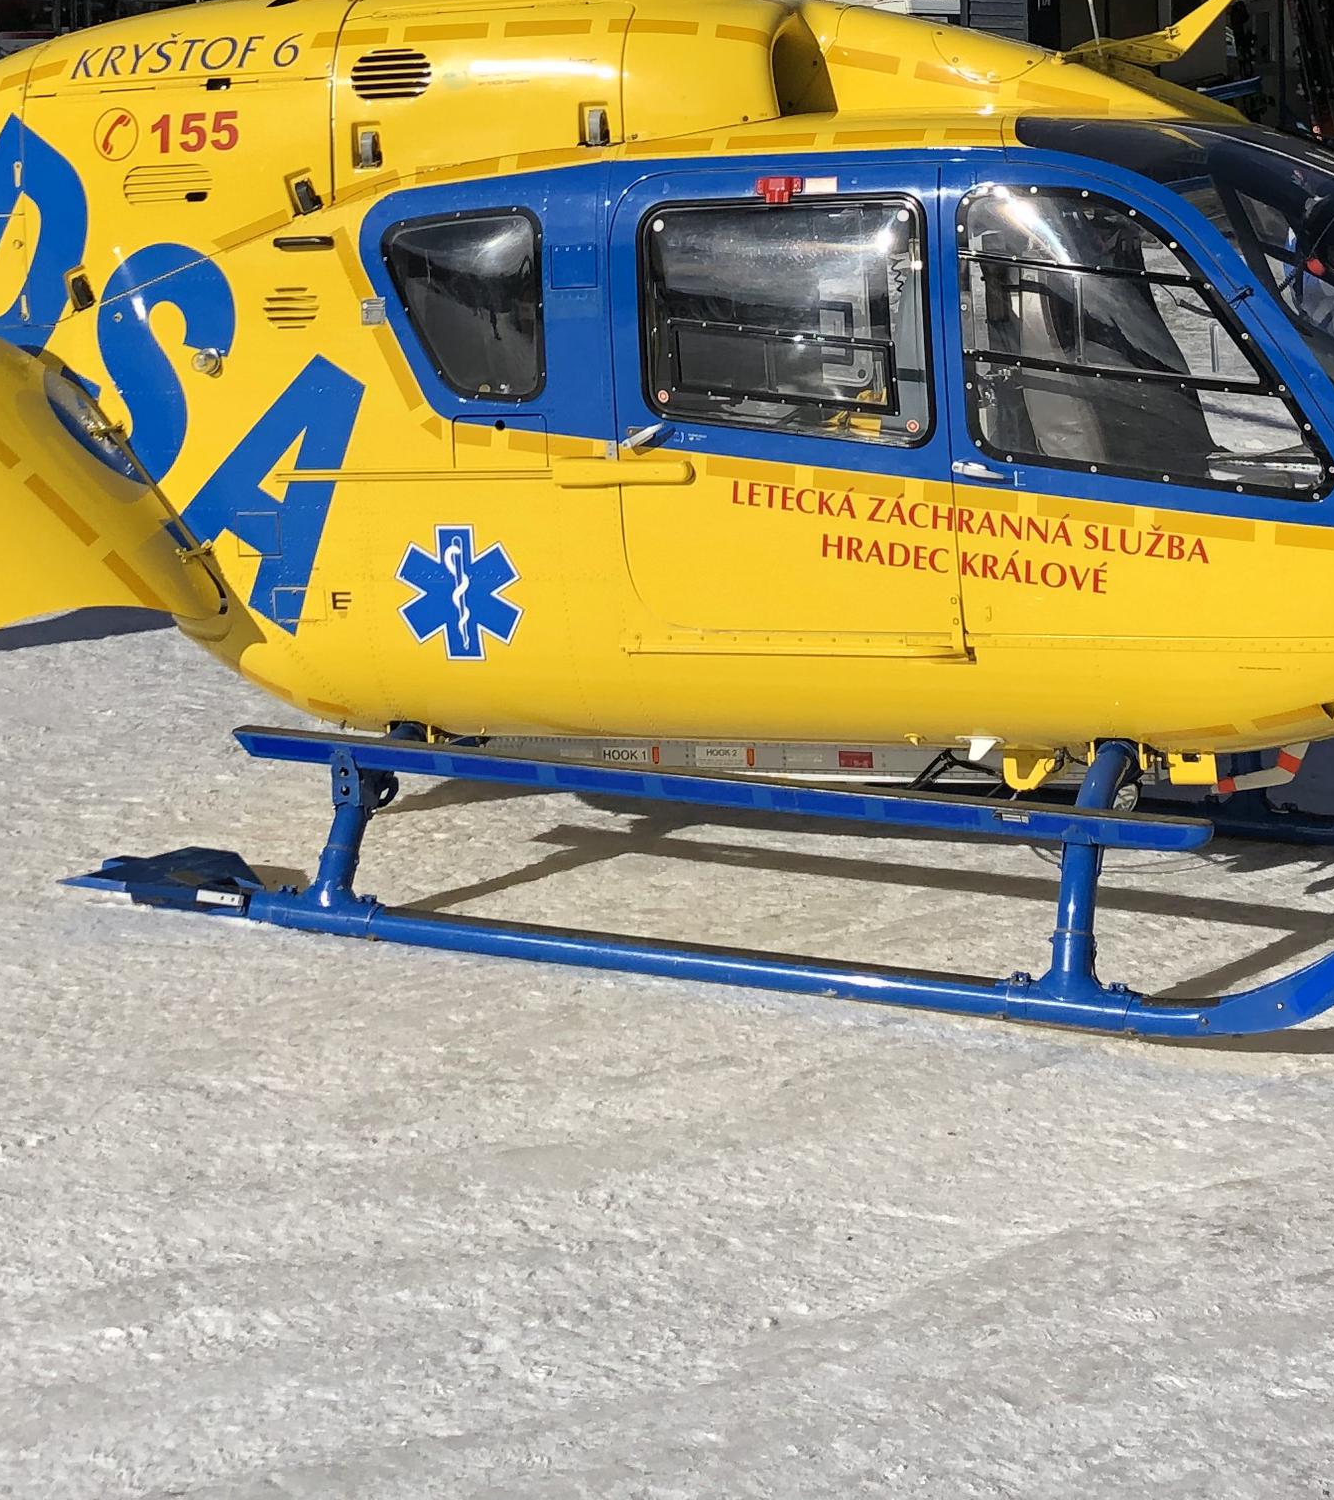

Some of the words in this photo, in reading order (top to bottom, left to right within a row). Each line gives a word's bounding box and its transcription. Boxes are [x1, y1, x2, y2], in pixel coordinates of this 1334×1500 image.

[70, 31, 265, 80] KRYŠTOF
[273, 33, 304, 68] 6
[151, 111, 239, 154] 155
[732, 480, 857, 520] LETECKÁ
[868, 493, 1072, 547] ZÁCHRANNÁ
[1084, 524, 1210, 564] SLUŽBA
[822, 534, 950, 574] HRADEC
[961, 550, 1108, 594] KRÁLOVÉ
[603, 749, 638, 761] HOOK
[641, 750, 647, 761] 1
[706, 748, 732, 758] HOOK
